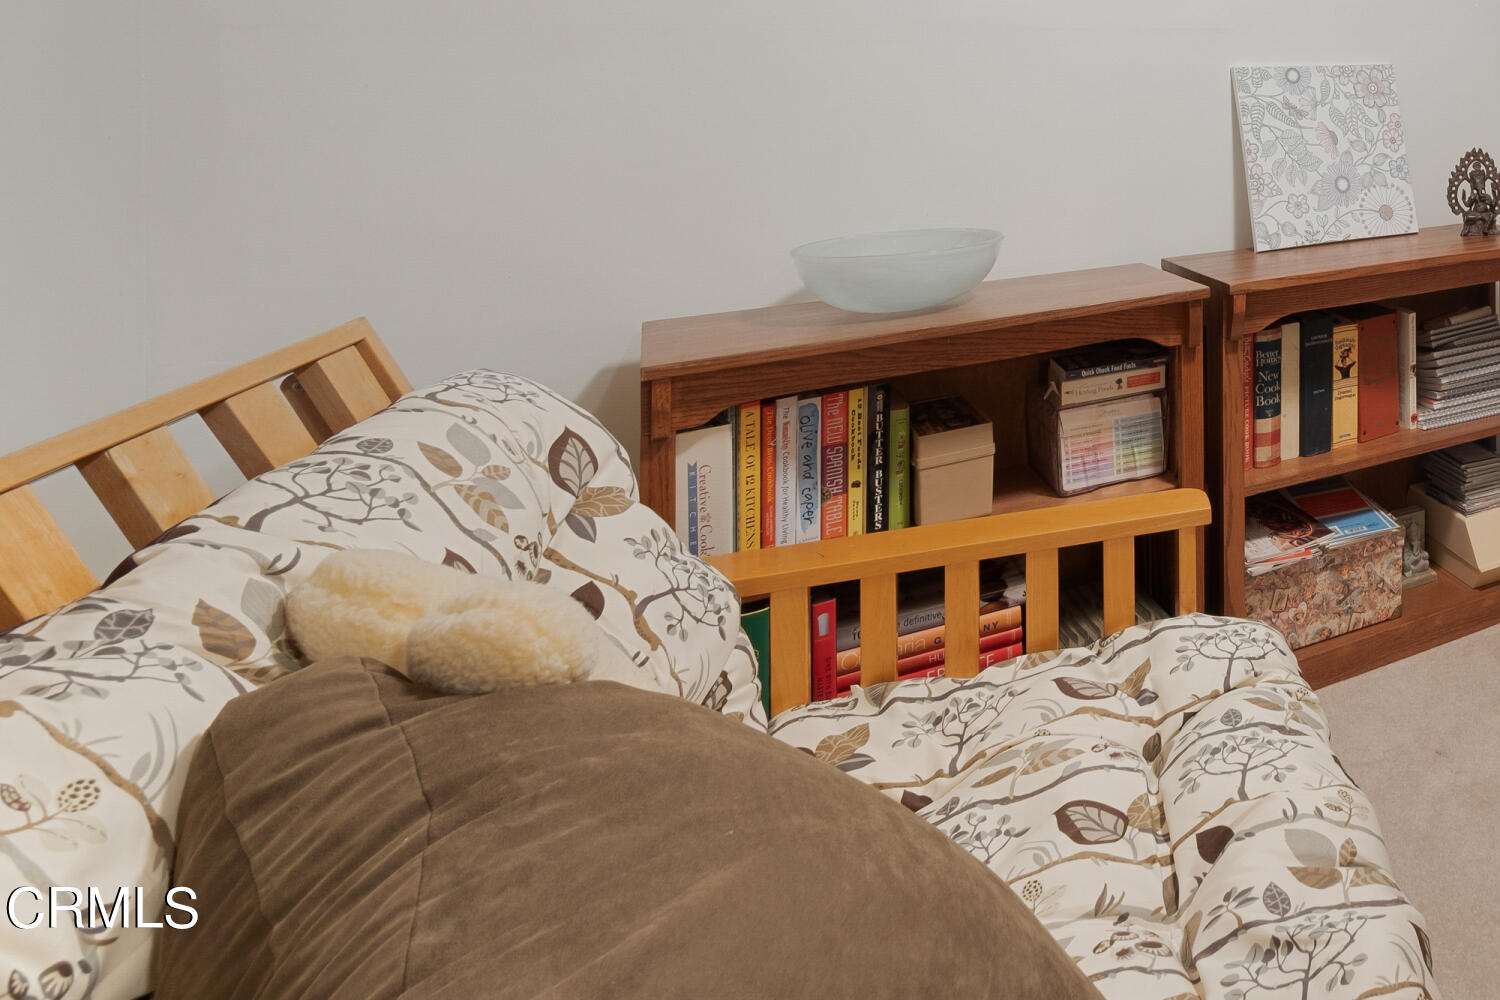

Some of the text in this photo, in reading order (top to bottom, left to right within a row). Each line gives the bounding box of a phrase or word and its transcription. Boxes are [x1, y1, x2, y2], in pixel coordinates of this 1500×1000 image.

[1081, 369, 1095, 377] Quick
[1259, 371, 1279, 382] New
[1256, 382, 1281, 393] Cook
[1256, 395, 1281, 407] Book
[745, 421, 755, 452] TALE
[746, 455, 755, 471] OF
[782, 452, 790, 484] Cookbook
[800, 415, 817, 525] olive and caper
[826, 393, 844, 535] The NEW SPANISH TABLE
[874, 414, 883, 530] BUTTER BUSTERS
[699, 464, 712, 513] Creative
[746, 474, 755, 485] 12
[781, 486, 789, 496] for
[745, 488, 755, 549] KITCHENS
[781, 497, 790, 522] Healthy
[781, 524, 789, 544] Living
